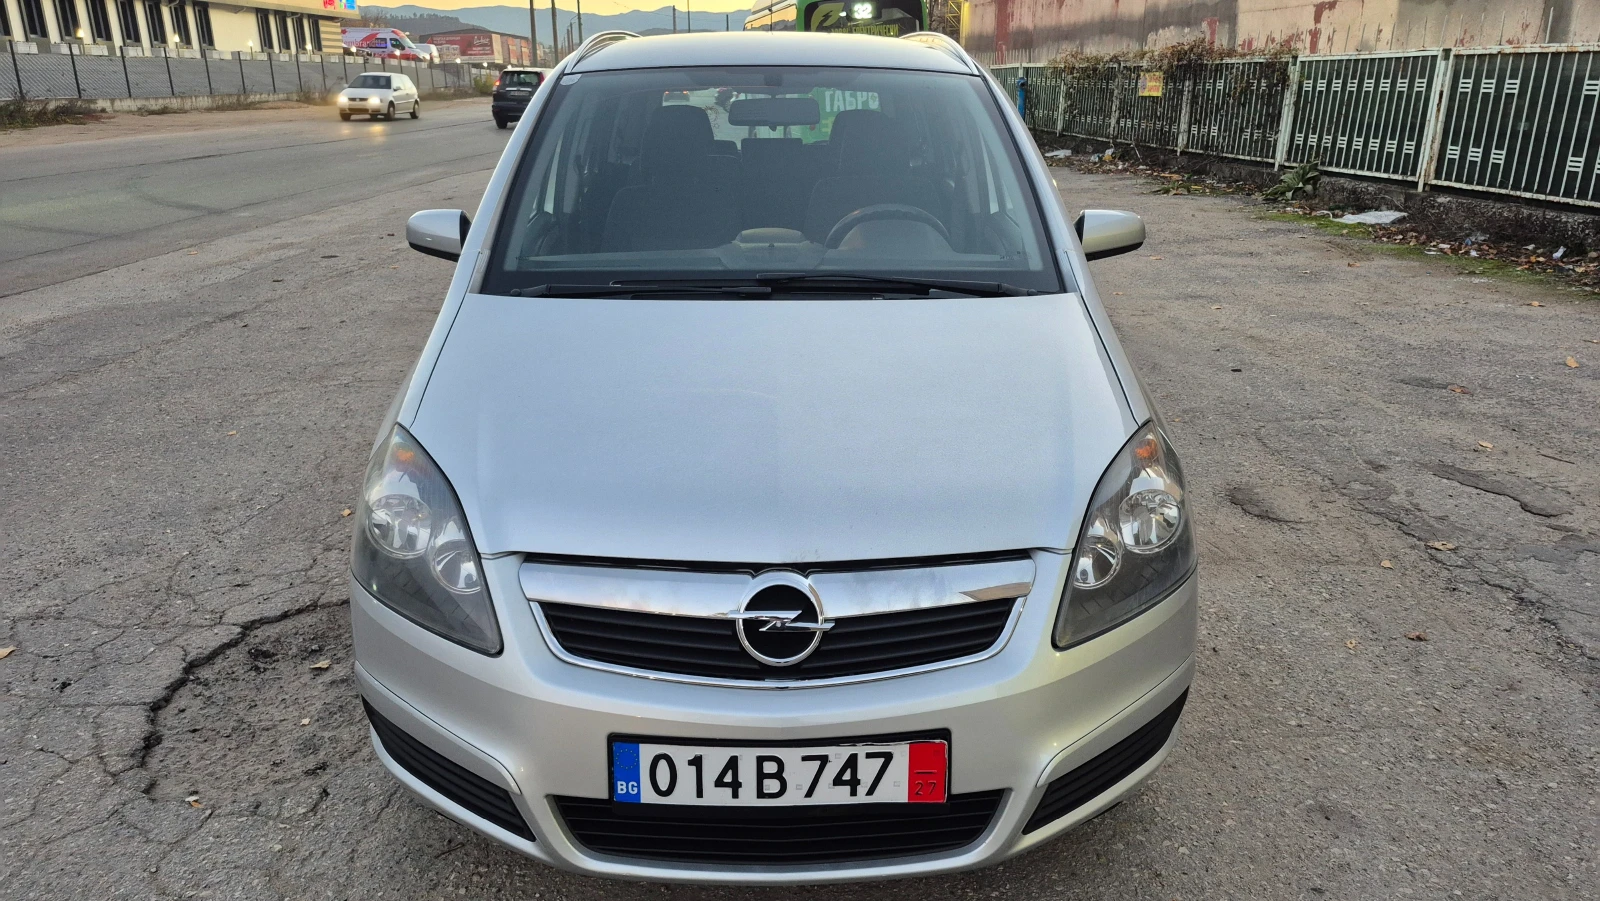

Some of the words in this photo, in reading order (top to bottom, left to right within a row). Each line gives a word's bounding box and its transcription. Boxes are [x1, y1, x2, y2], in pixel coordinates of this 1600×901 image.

[854, 3, 872, 19] 32
[617, 781, 638, 794] BG
[914, 780, 937, 795] 27
